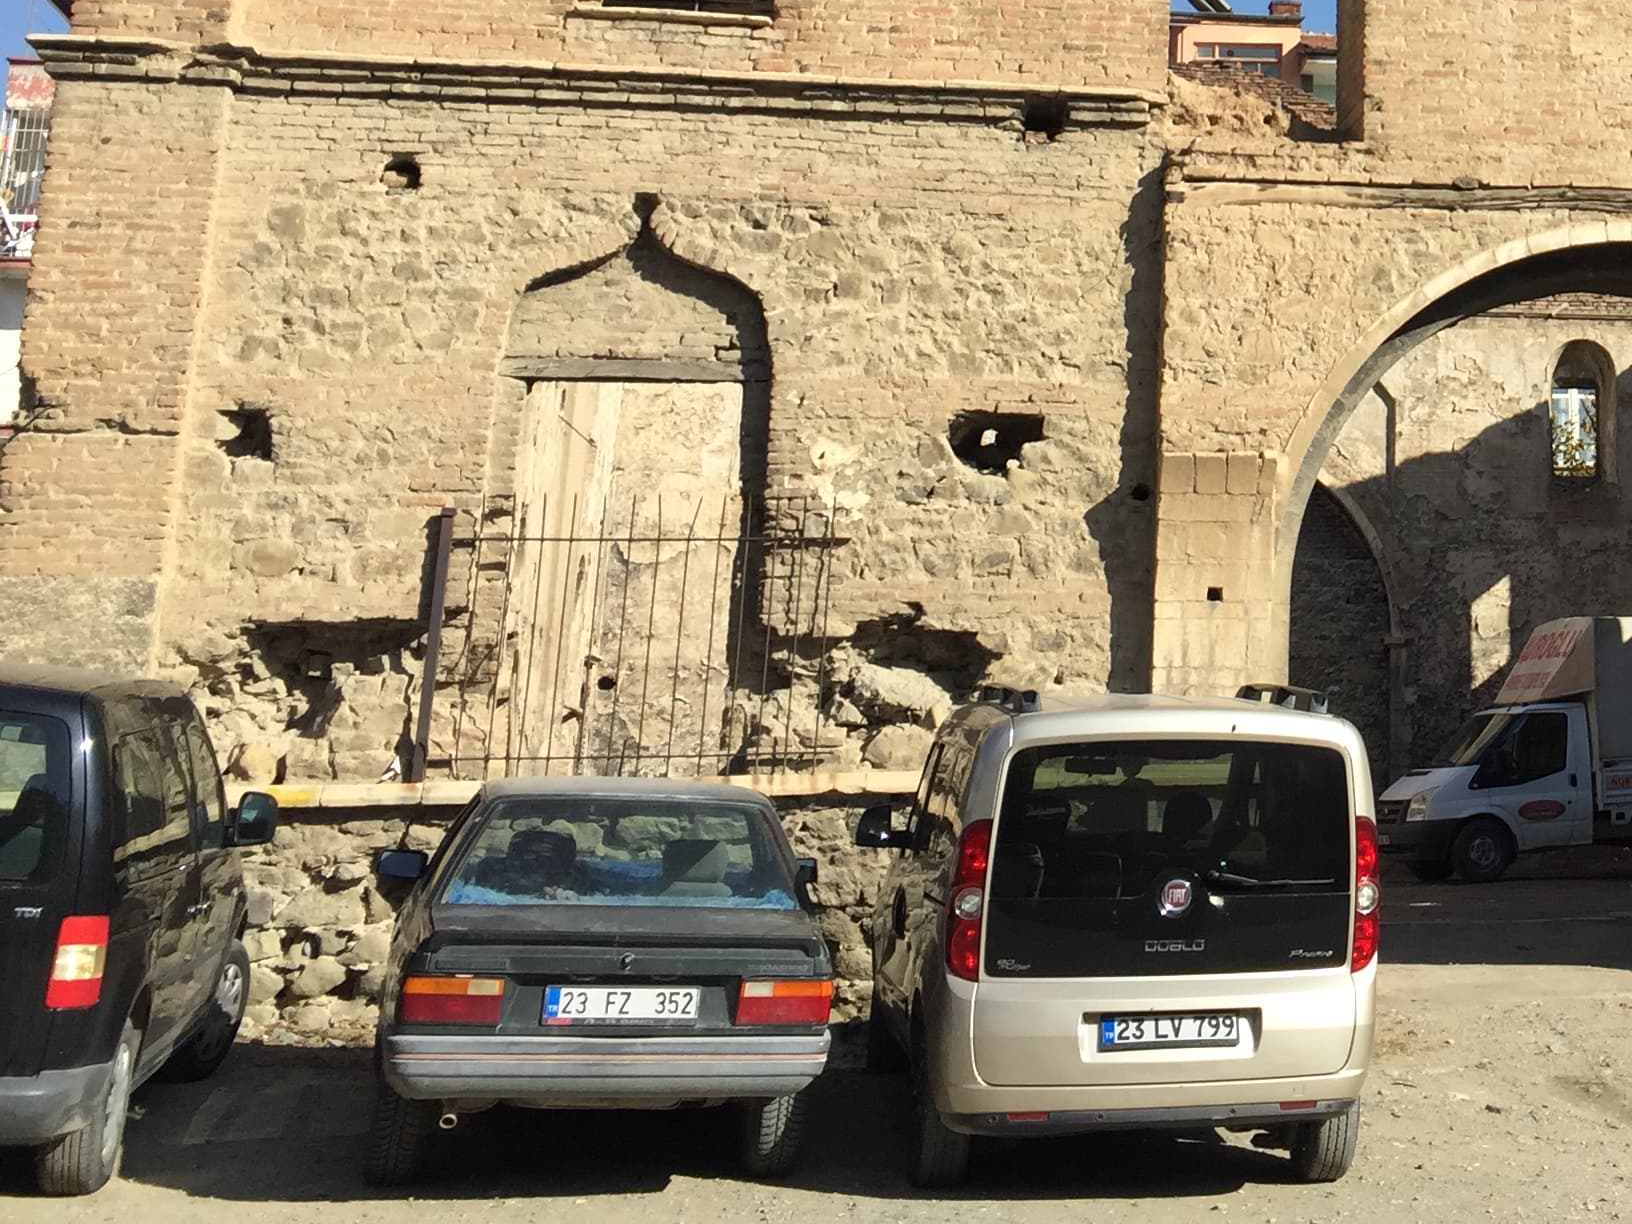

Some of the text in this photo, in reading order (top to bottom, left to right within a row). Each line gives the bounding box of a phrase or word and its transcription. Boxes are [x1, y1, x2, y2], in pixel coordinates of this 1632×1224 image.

[1168, 888, 1187, 904] FIAT
[1144, 939, 1206, 952] DOBLO
[561, 991, 588, 1015] 23
[605, 991, 632, 1015] FZ
[655, 991, 694, 1015] 352
[1117, 1019, 1144, 1040] 23
[1155, 1017, 1184, 1039] LV
[1193, 1015, 1234, 1037] 799
